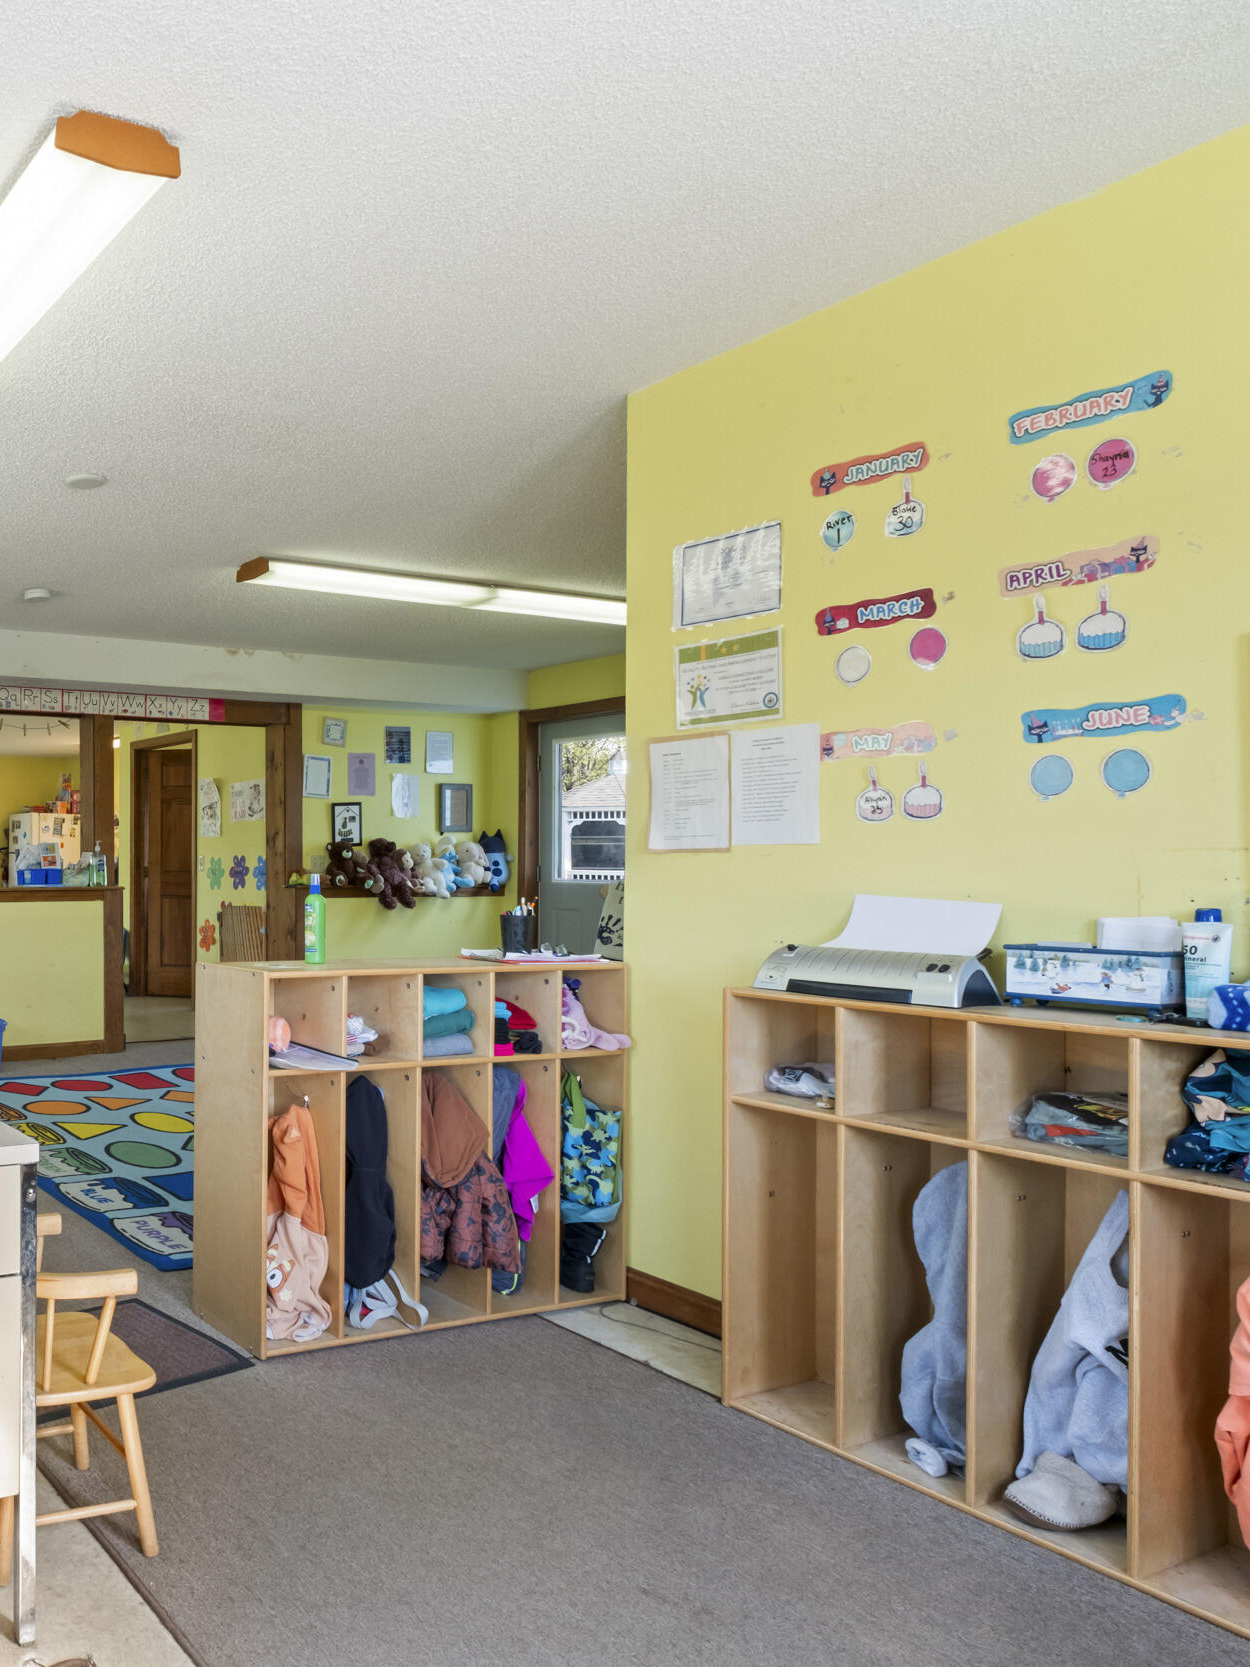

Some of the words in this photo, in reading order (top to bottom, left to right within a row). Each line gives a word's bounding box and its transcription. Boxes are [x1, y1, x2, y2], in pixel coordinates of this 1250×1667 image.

[1014, 387, 1133, 436] FEBRUARY
[844, 448, 924, 484] JANUARY
[1091, 449, 1129, 467] Shayna
[1101, 465, 1118, 478] 23
[825, 514, 853, 531] River
[894, 515, 914, 531] 30
[1007, 562, 1071, 590] APRIL
[858, 597, 924, 623] MARCH
[23, 688, 39, 704] Rr
[44, 690, 59, 704] Ss
[64, 691, 79, 705] Tt
[82, 692, 98, 706] Uu
[102, 694, 115, 707] Vv
[120, 695, 145, 708] Ww
[148, 697, 163, 709] Xx
[170, 698, 183, 717] Yy
[190, 699, 205, 712] Zz
[1082, 704, 1149, 730] JUNE
[852, 732, 893, 753] MAY
[80, 1187, 115, 1204] BLUE
[130, 1219, 188, 1250] PURPLE
